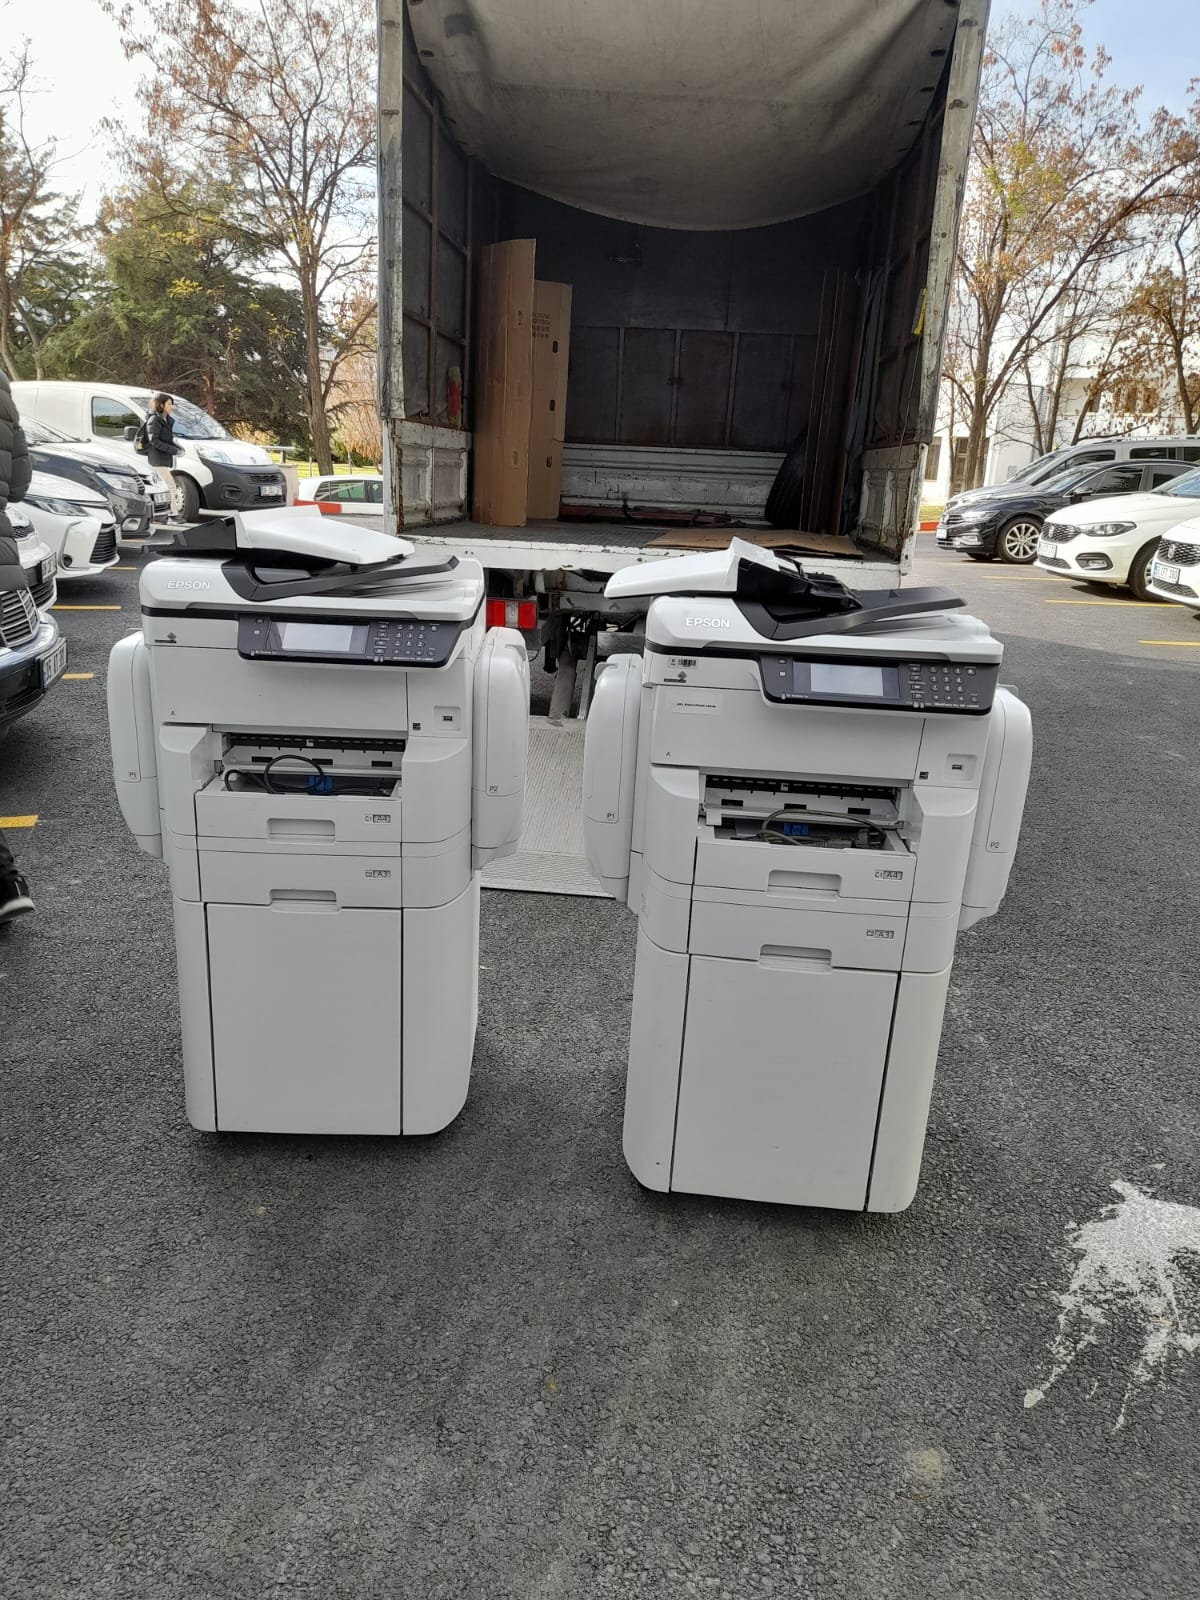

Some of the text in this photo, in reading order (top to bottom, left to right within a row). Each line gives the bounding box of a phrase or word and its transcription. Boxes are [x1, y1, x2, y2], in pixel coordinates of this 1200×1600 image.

[167, 579, 210, 591] EPSON
[686, 616, 730, 629] EPSON
[990, 841, 1000, 849] P2
[874, 870, 899, 879] C1 A4
[866, 929, 890, 939] C2 A3
